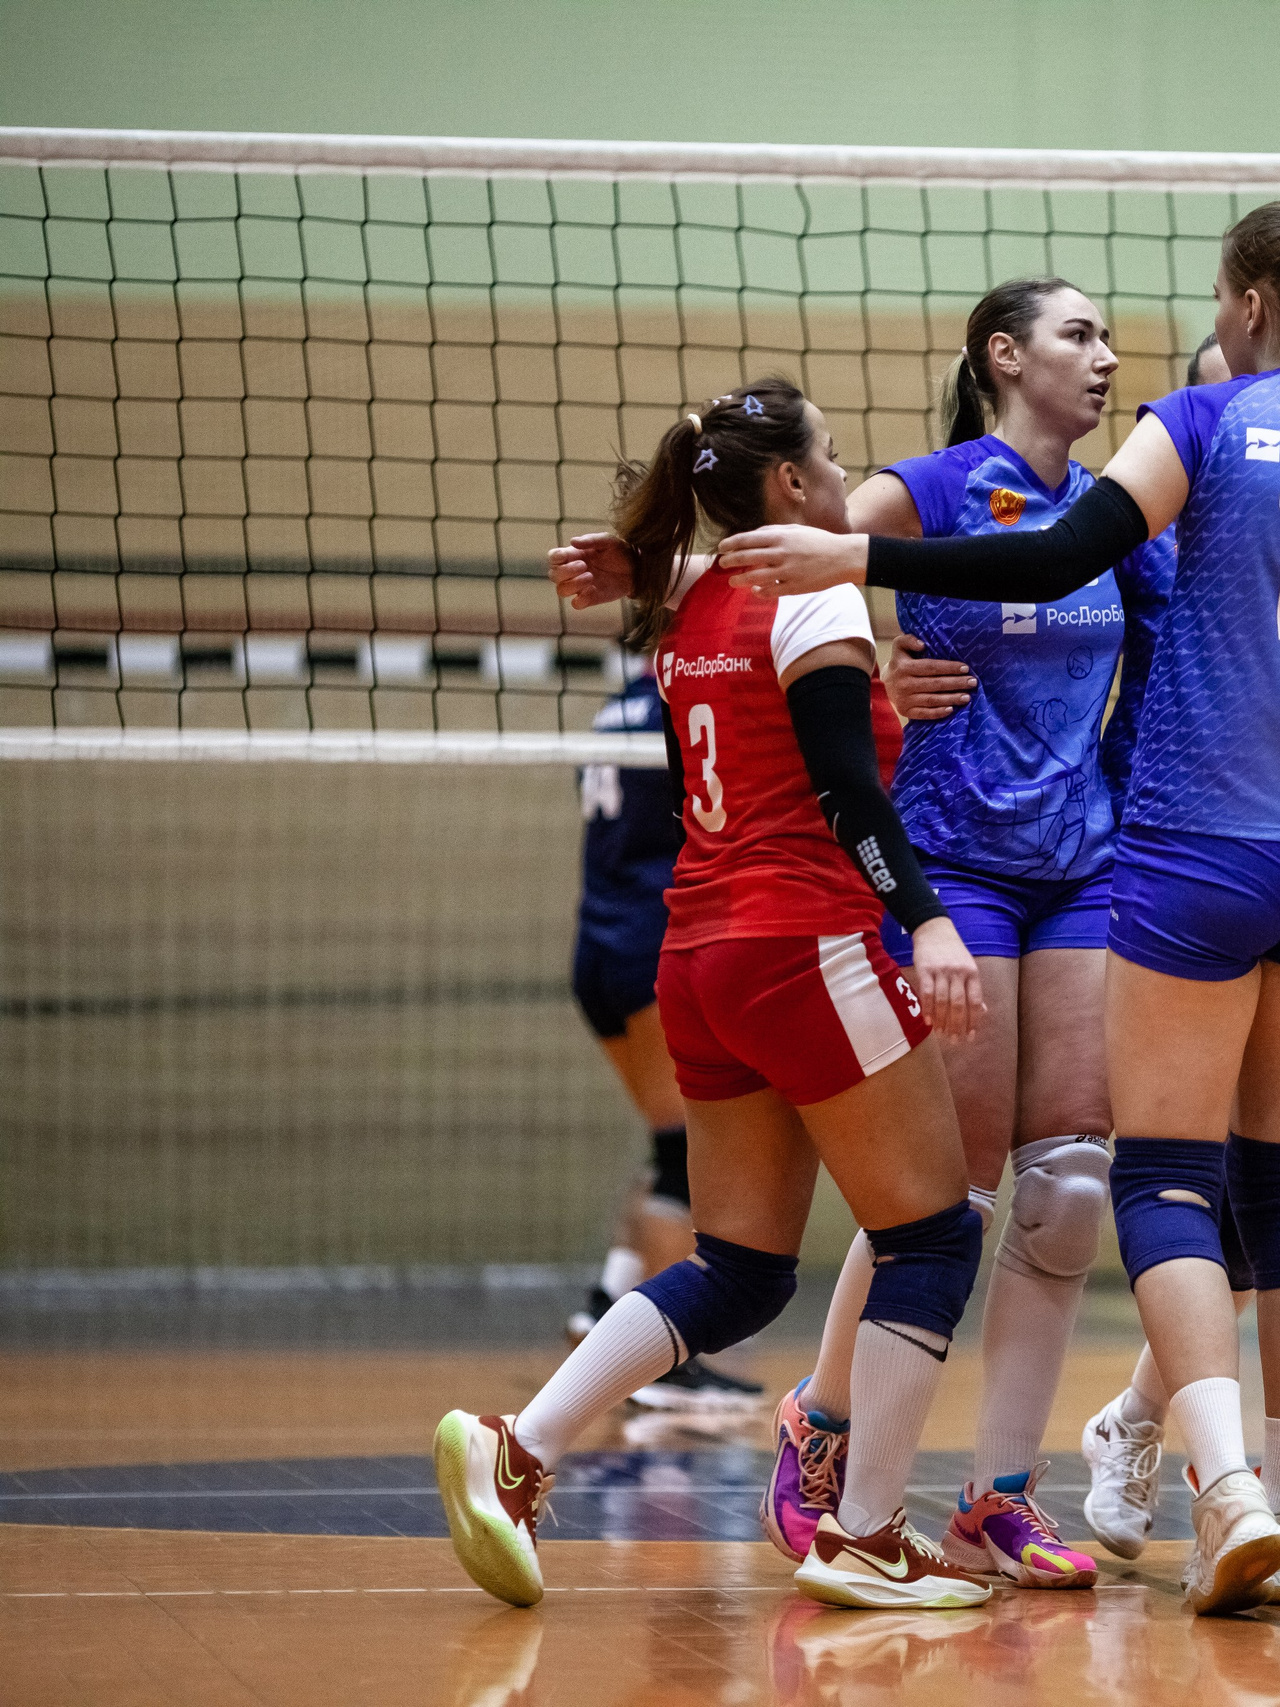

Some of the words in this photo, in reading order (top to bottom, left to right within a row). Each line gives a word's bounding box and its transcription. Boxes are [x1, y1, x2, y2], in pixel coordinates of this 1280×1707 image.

[675, 653, 753, 678] РосДорБанк
[688, 703, 728, 833] 3
[866, 857, 898, 893] cep
[896, 976, 921, 1018] 3
